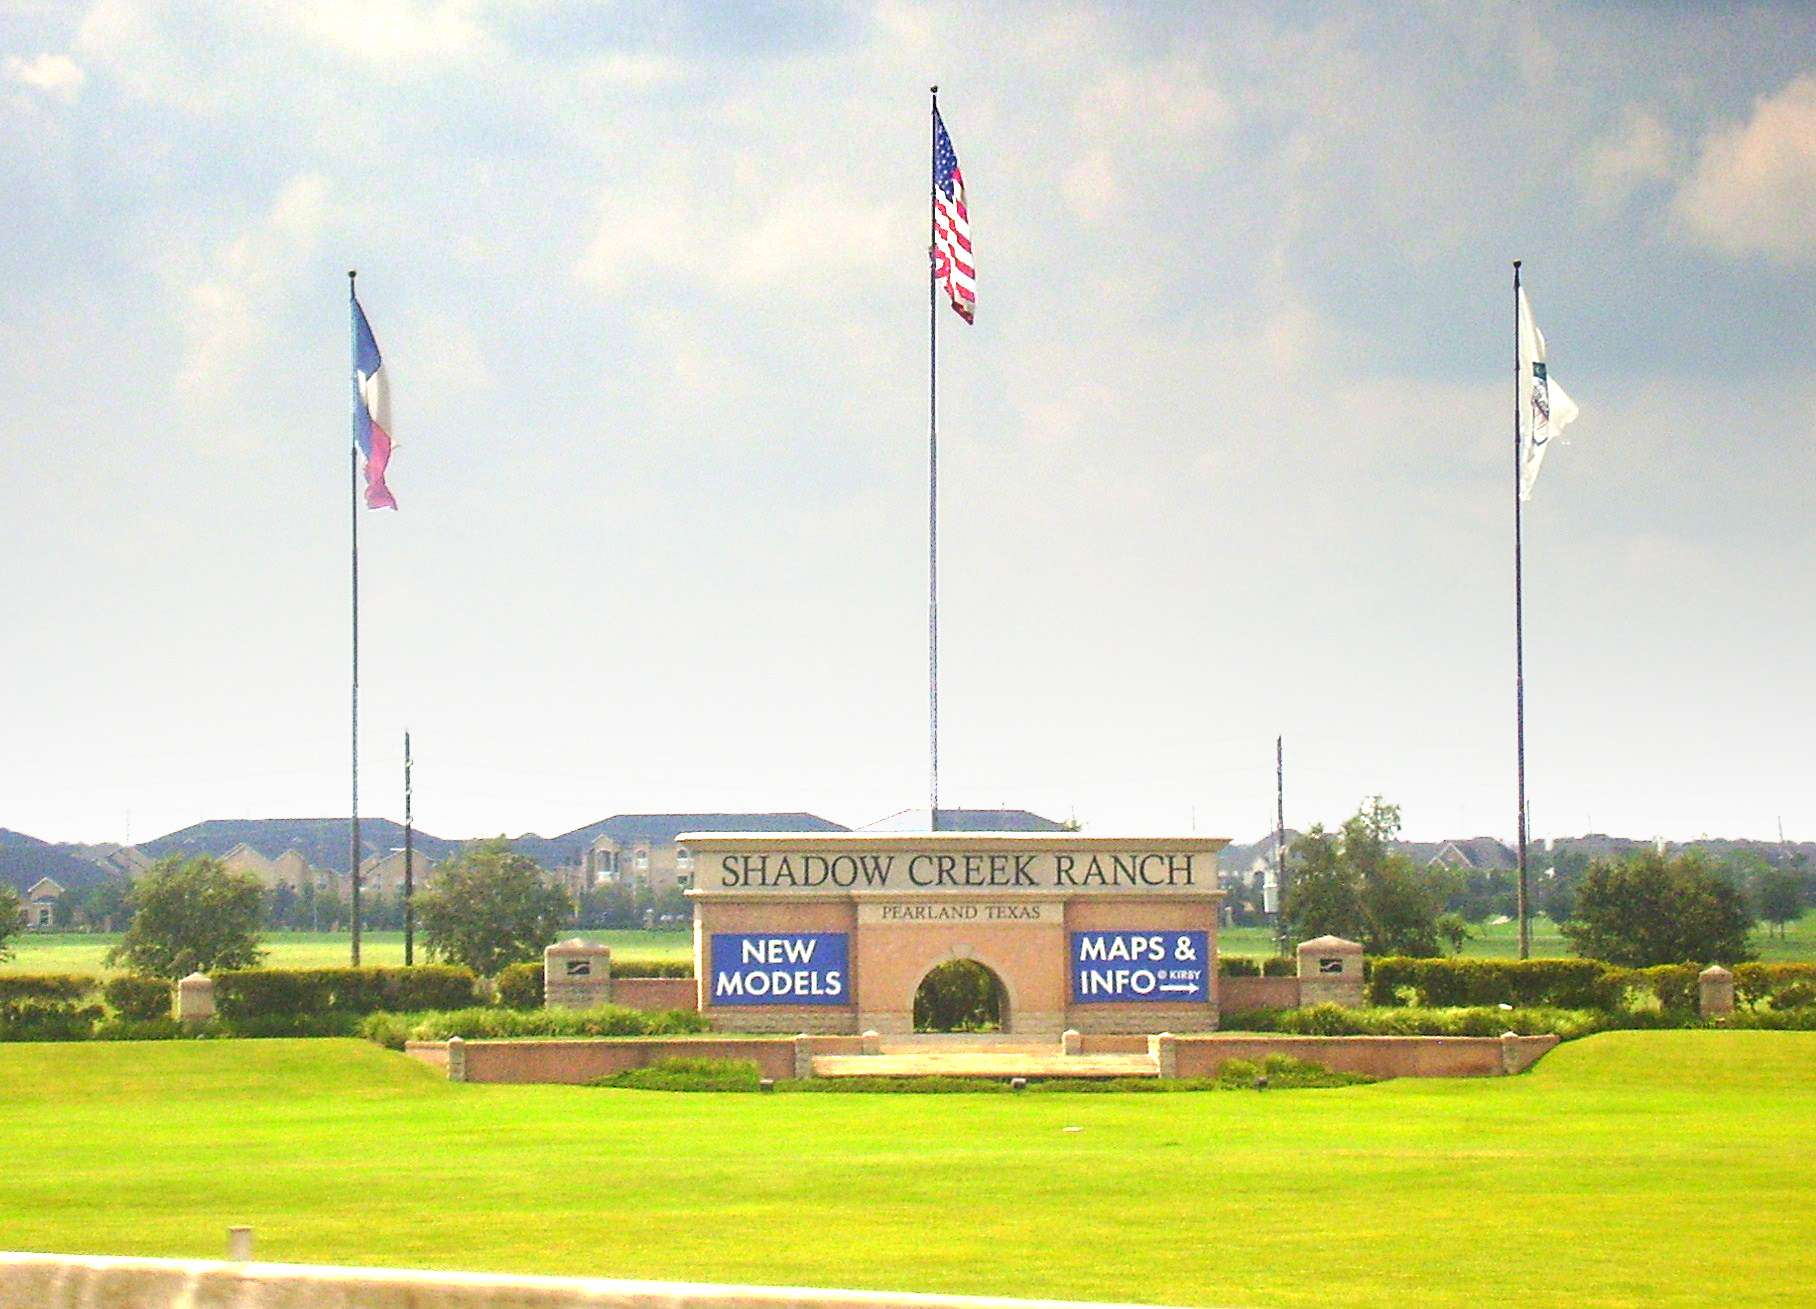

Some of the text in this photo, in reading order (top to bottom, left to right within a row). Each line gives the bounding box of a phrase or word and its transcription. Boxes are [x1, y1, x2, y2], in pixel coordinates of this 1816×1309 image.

[722, 853, 1195, 887] SHADOW CREEK RANCH
[882, 905, 1040, 919] PEARLAND TEXAS
[741, 938, 816, 964] NEW
[1080, 936, 1197, 961] MAPS &
[716, 970, 842, 996] MODELS
[1081, 969, 1157, 994] INFO
[1170, 969, 1201, 980] KIRBY
